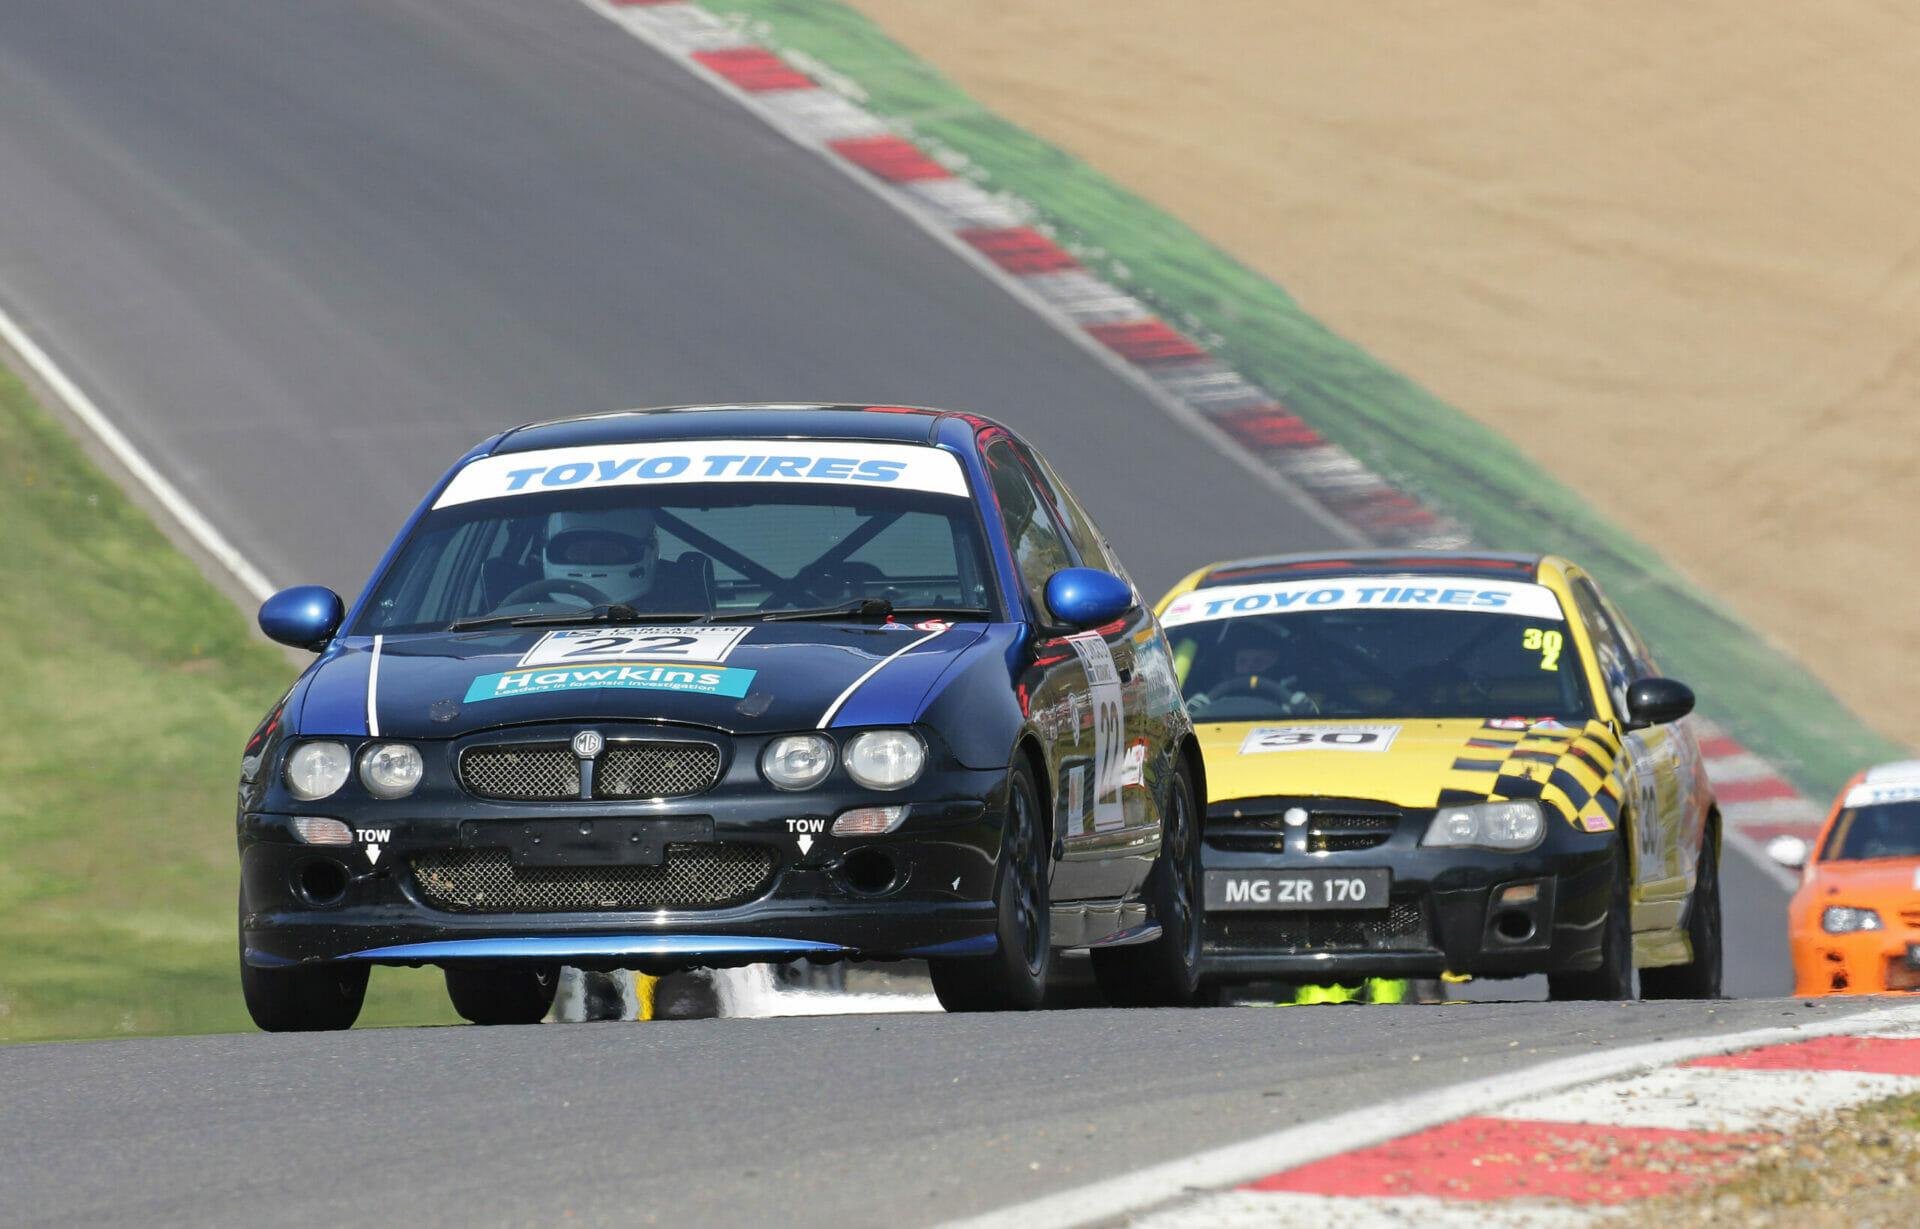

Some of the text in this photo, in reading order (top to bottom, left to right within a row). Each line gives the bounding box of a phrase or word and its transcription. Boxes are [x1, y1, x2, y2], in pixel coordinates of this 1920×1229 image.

[505, 455, 907, 491] TOYO TIRES
[1204, 587, 1512, 616] TOYO TIRES
[560, 635, 698, 657] 22
[1522, 628, 1563, 651] 30
[495, 685, 549, 696] Leaders
[569, 679, 625, 688] forensic
[628, 679, 717, 692] investigation
[496, 667, 721, 690] Hawkins
[576, 733, 599, 753] MG
[1259, 732, 1379, 747] 30
[1098, 701, 1119, 804] 22
[356, 829, 391, 843] TOW
[786, 819, 825, 833] TOW
[1225, 878, 1367, 903] MG ZR 170
